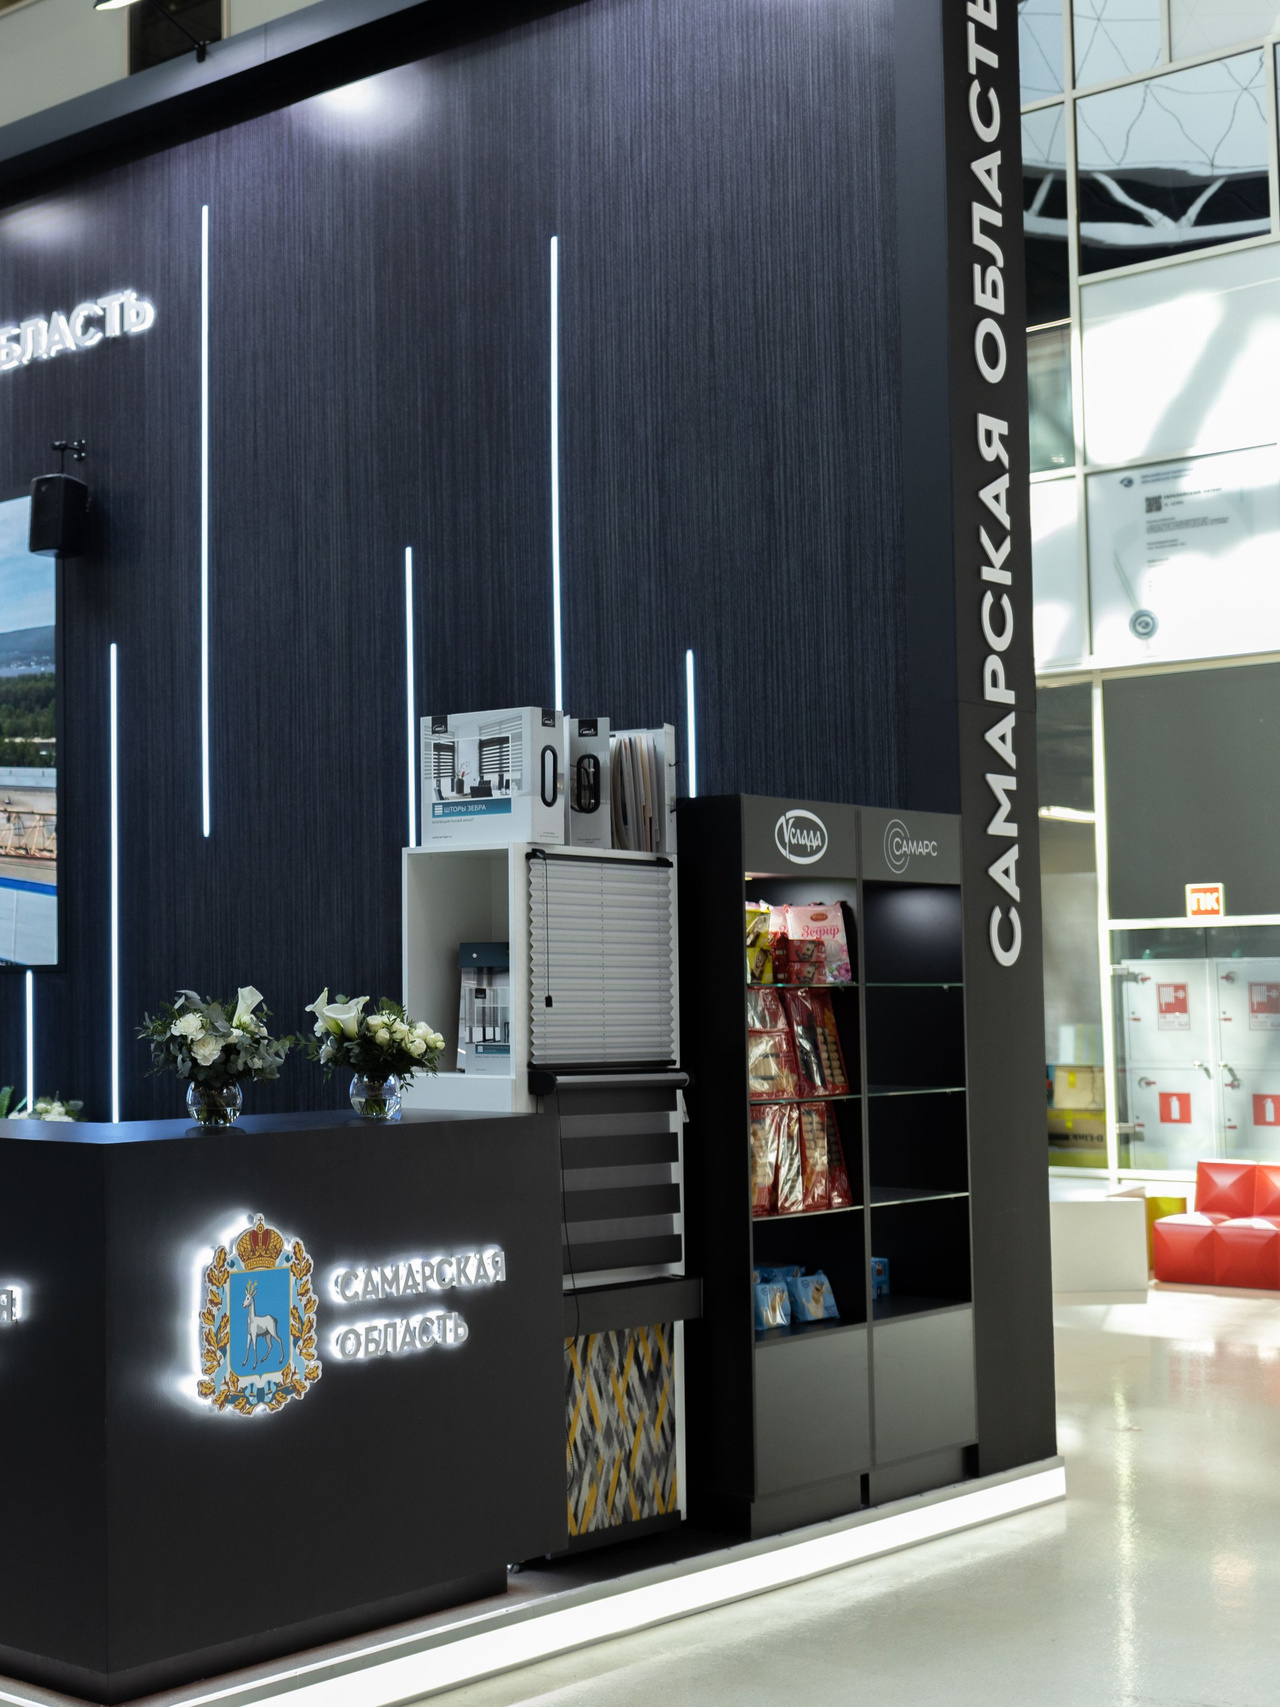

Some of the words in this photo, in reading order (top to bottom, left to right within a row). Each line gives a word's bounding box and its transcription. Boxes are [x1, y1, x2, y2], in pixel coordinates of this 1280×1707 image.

[977, 413, 1022, 967] САМАРСКАЯ
[444, 805, 467, 813] ШТОРЫ
[467, 804, 487, 812] ЗЕБРА
[893, 837, 938, 856] САМАРС
[1190, 892, 1220, 911] ПК
[801, 925, 840, 939] Зефир
[339, 1250, 507, 1303] САМАРСКАЯ
[338, 1312, 470, 1361] ОБЛАСТЬ
